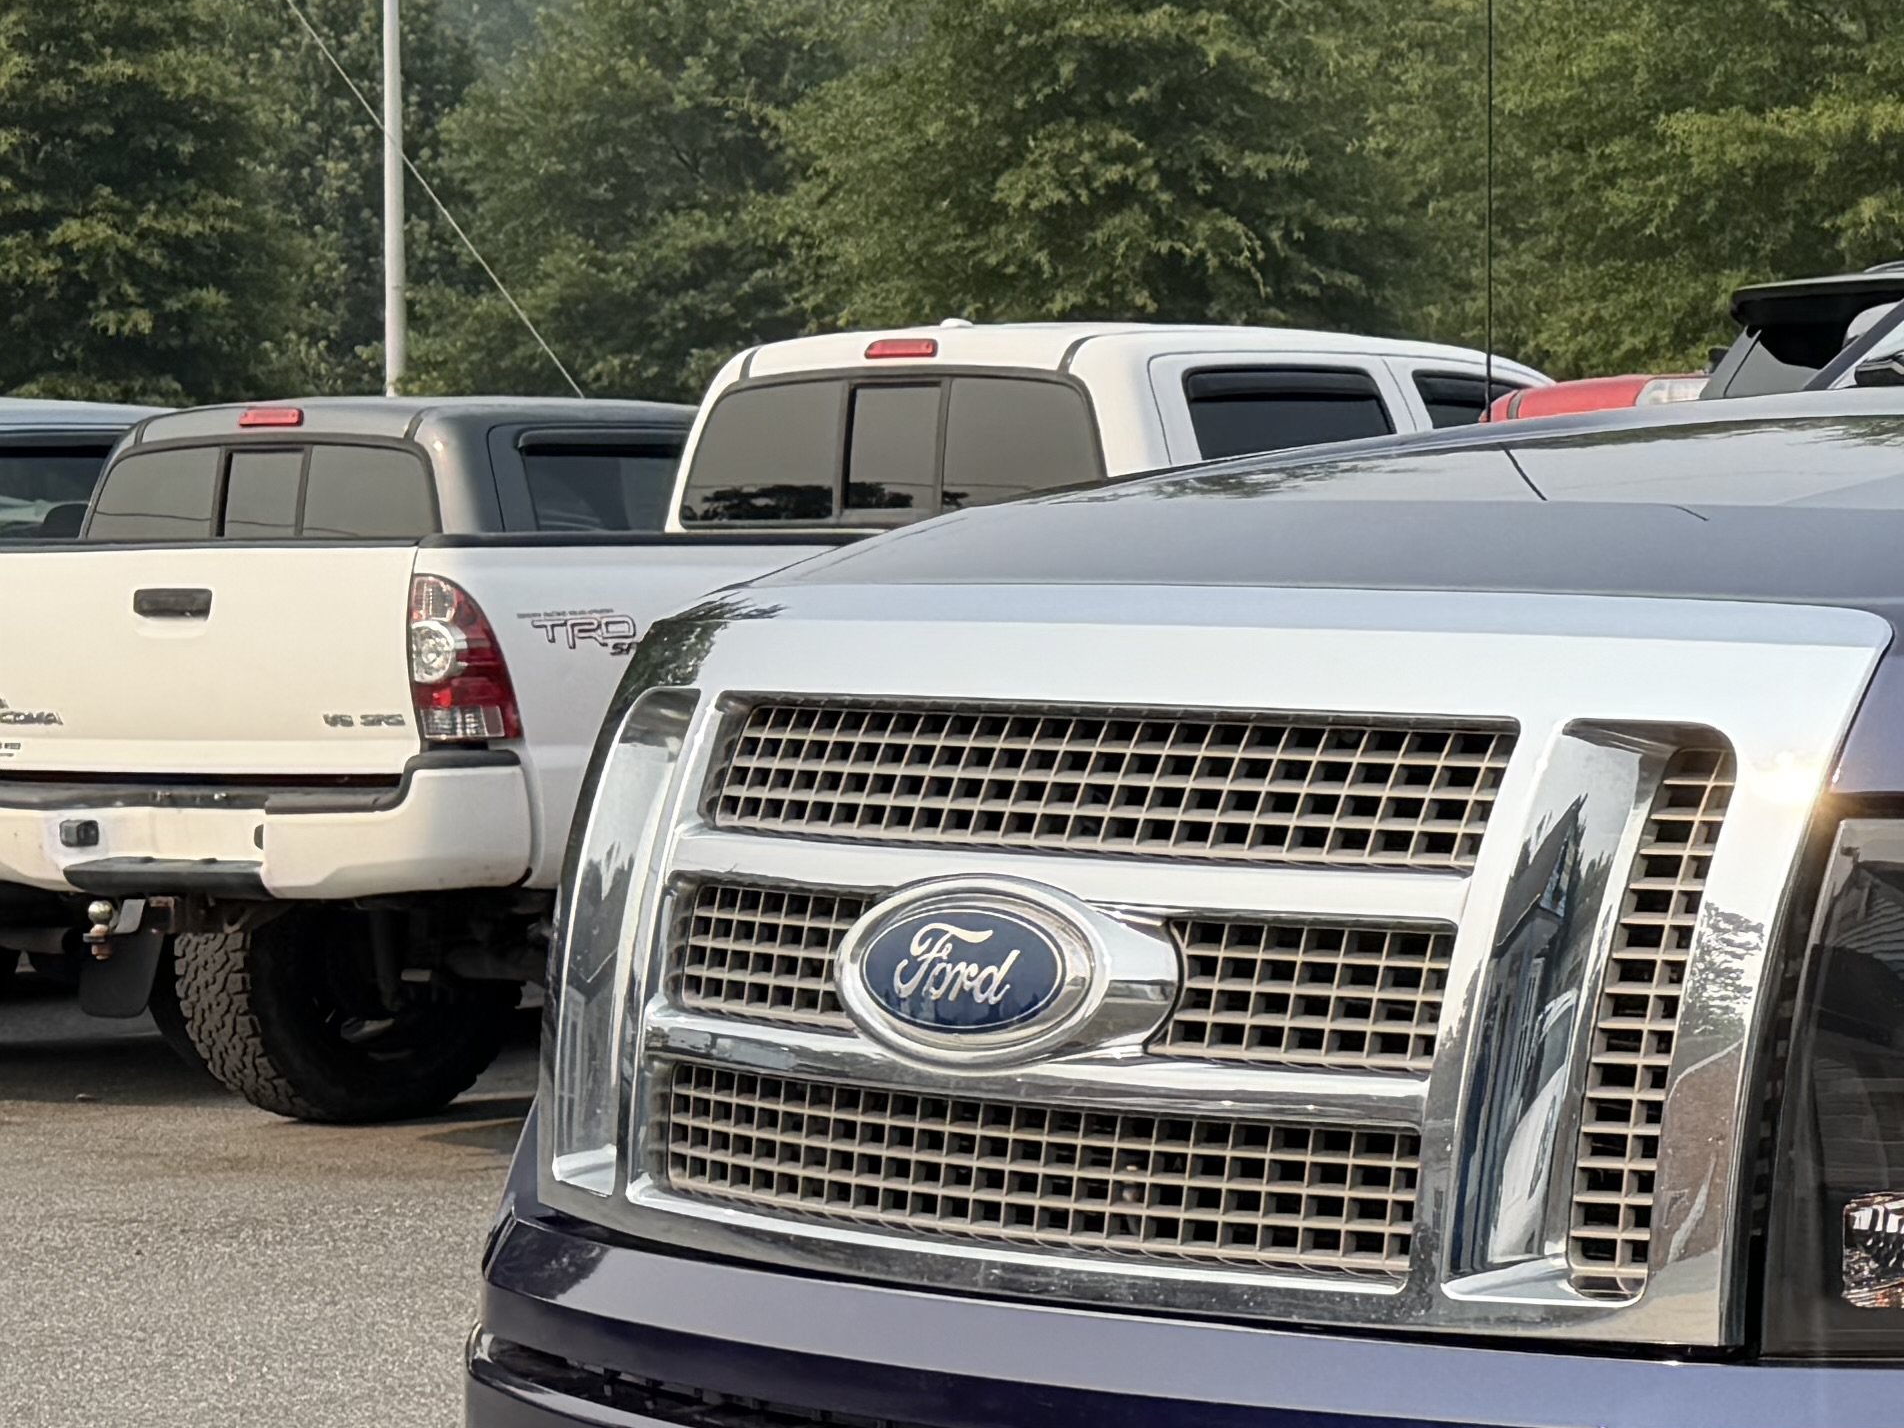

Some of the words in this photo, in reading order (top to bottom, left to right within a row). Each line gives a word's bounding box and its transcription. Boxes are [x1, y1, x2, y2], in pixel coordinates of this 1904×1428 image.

[531, 615, 636, 649] TRD
[322, 714, 354, 727] V6
[894, 923, 1020, 1005] Ford
